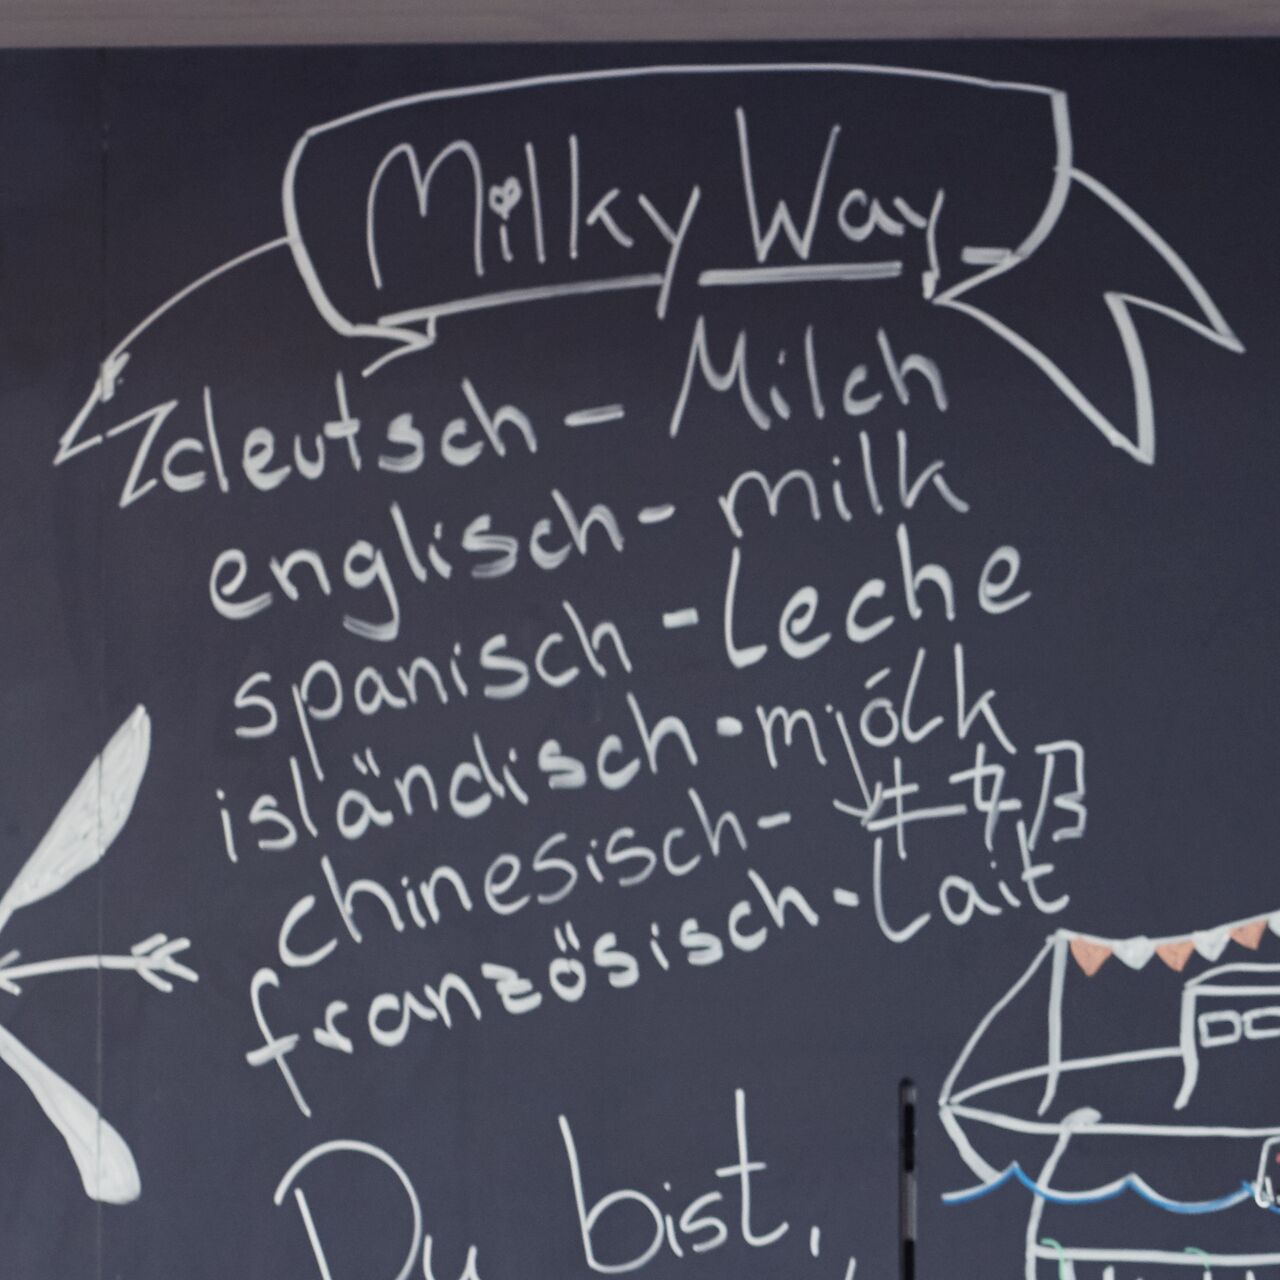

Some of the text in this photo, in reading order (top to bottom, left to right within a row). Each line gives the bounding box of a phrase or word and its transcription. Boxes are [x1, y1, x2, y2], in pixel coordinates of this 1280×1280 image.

[367, 105, 946, 320] Milky Way
[670, 315, 949, 438] Milch
[717, 430, 970, 538] milk
